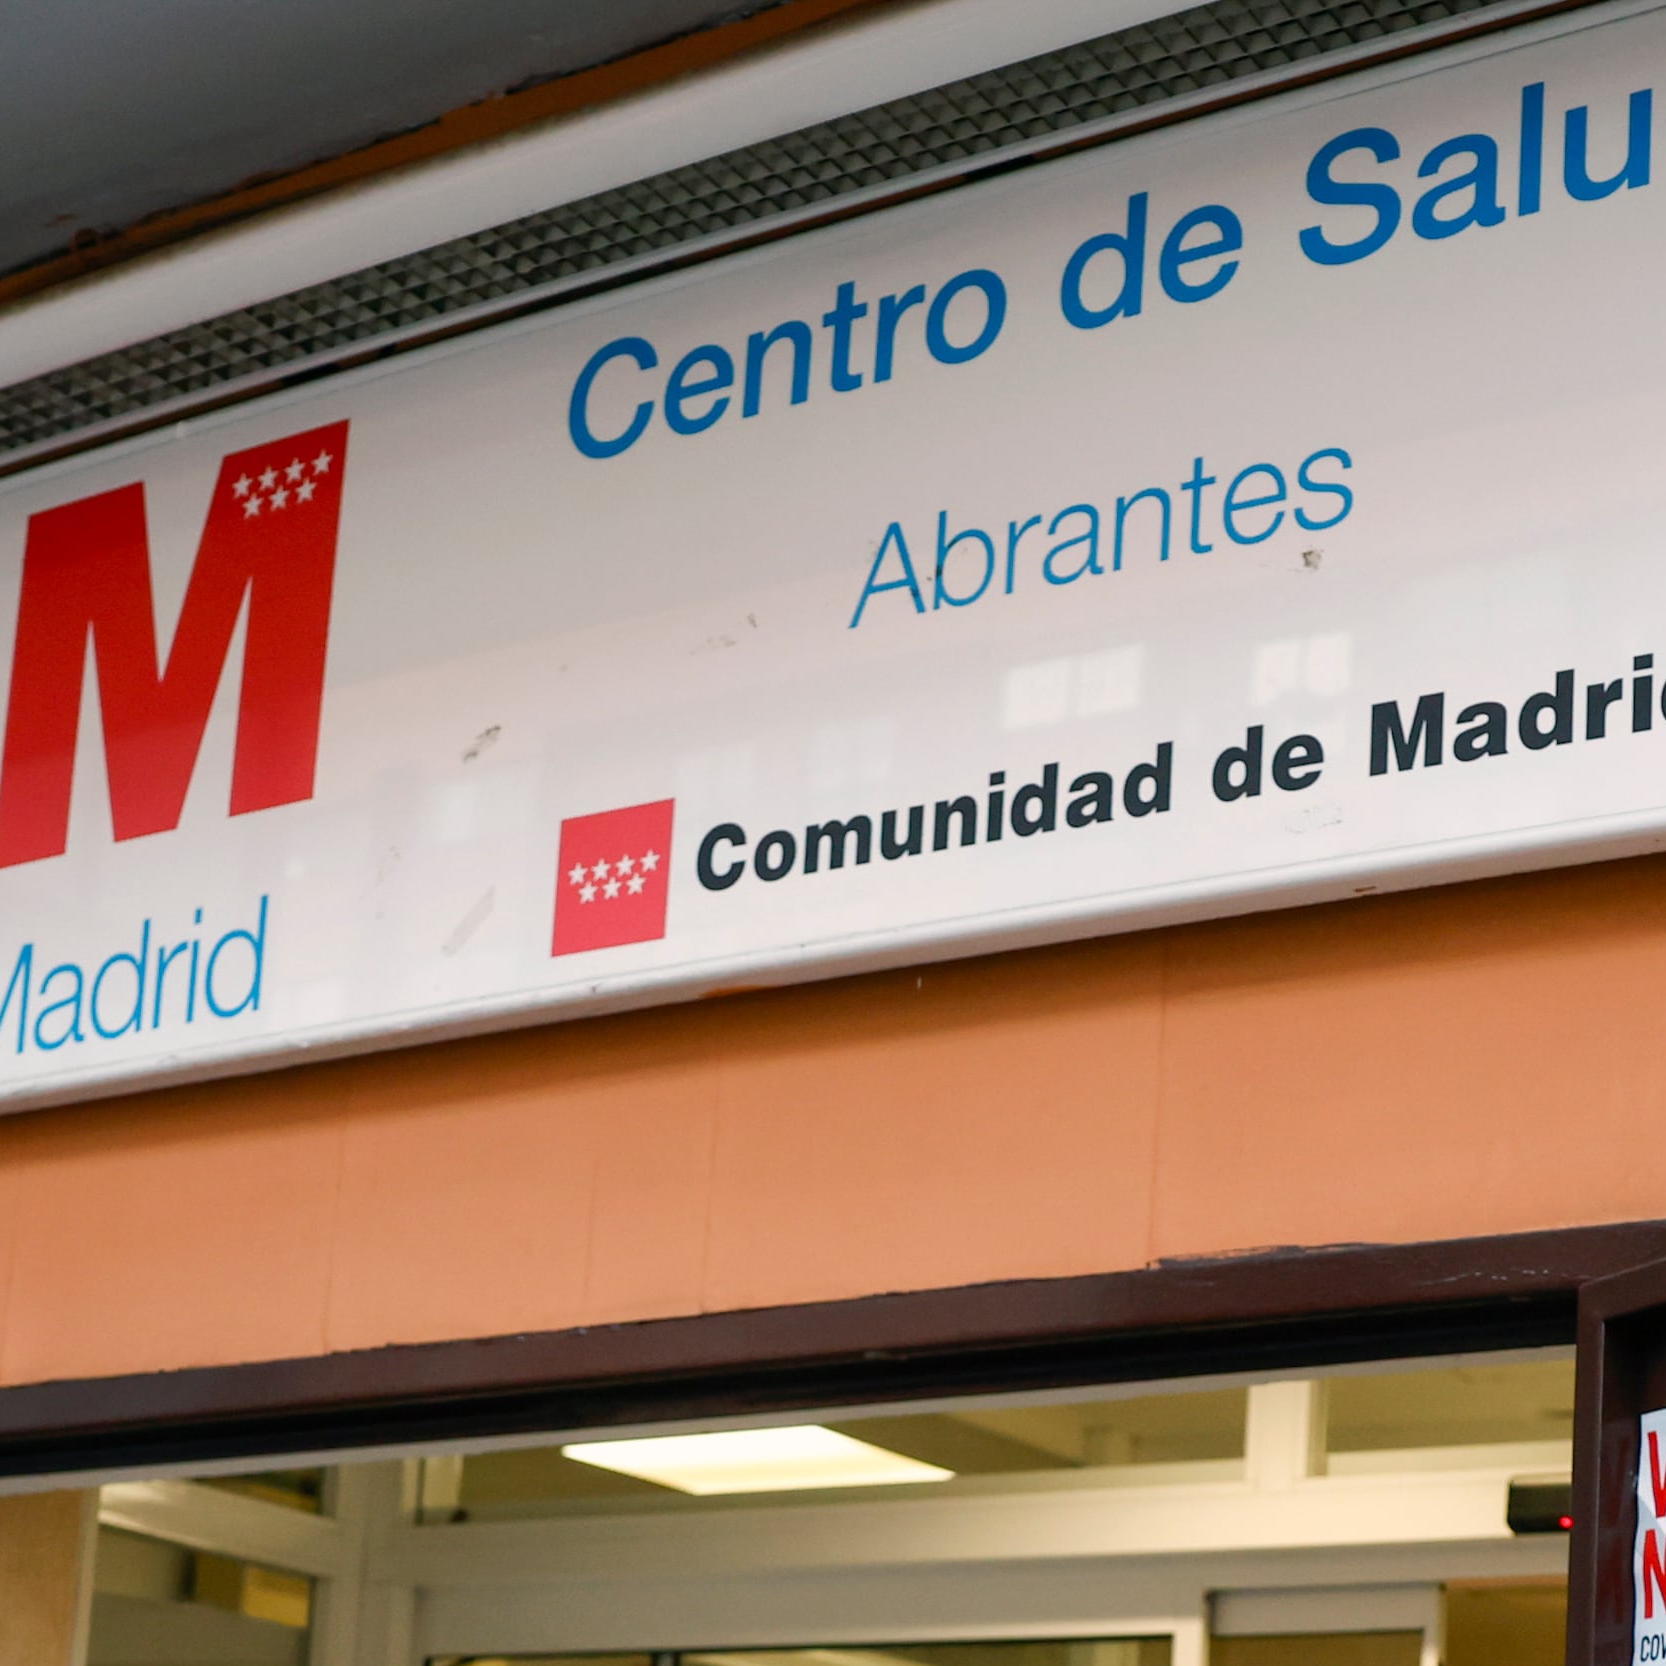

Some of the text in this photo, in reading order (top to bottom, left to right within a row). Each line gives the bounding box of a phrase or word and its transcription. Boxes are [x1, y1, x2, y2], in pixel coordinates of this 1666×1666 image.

[567, 265, 1008, 460] Centro
[1058, 192, 1243, 332] de
[849, 443, 1355, 631] Abrantes
[694, 740, 1174, 893] Comunidad
[1210, 724, 1325, 799] de
